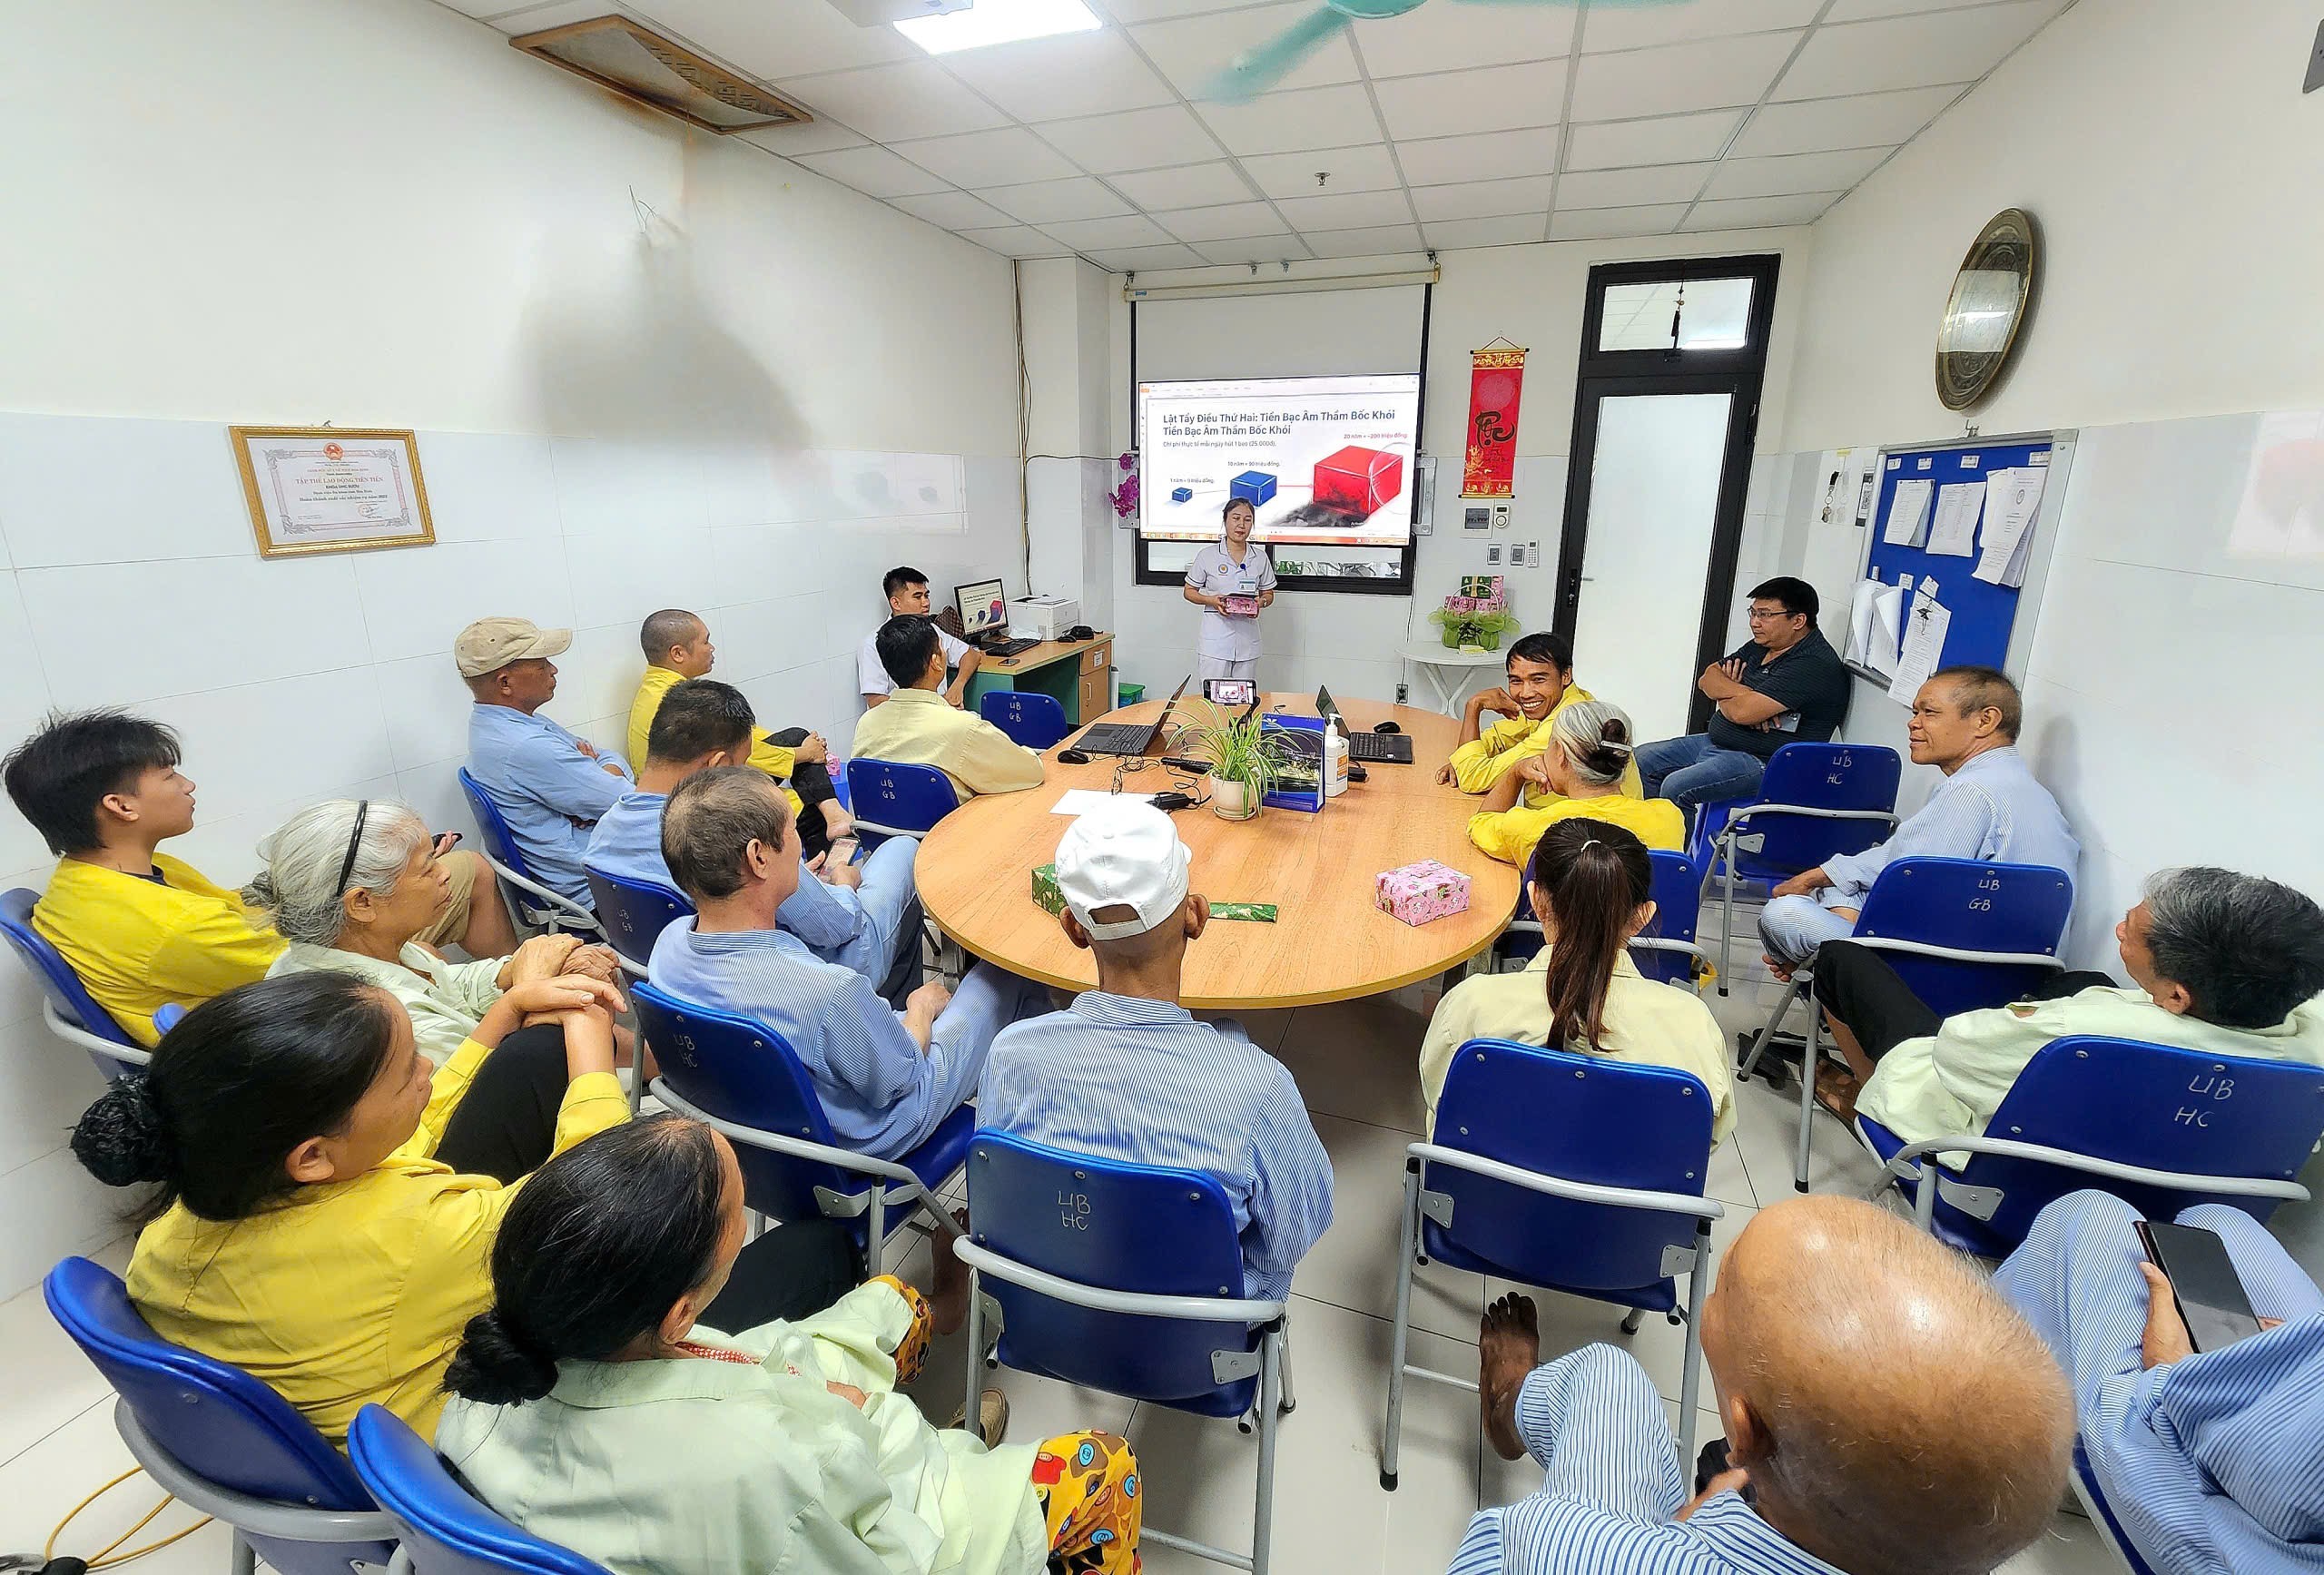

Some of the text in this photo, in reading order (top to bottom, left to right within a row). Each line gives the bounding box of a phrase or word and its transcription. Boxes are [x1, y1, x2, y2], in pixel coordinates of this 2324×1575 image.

[1163, 414, 1177, 426] Lật
[1219, 412, 1238, 423] Thứ
[1240, 412, 1258, 422] Hai:
[1283, 412, 1300, 424] Bạc
[1302, 410, 1318, 421] Âm
[1351, 409, 1370, 420] Bốc
[1372, 409, 1395, 420] Khói
[1185, 427, 1201, 438] Bạc
[1203, 424, 1218, 436] Âm
[1249, 424, 1267, 435] Bốc
[1269, 425, 1291, 435] Khói
[1827, 773, 1844, 784] HC
[1969, 898, 1991, 911] GB
[2174, 1107, 2216, 1127] HC
[1061, 1210, 1088, 1231] HC
